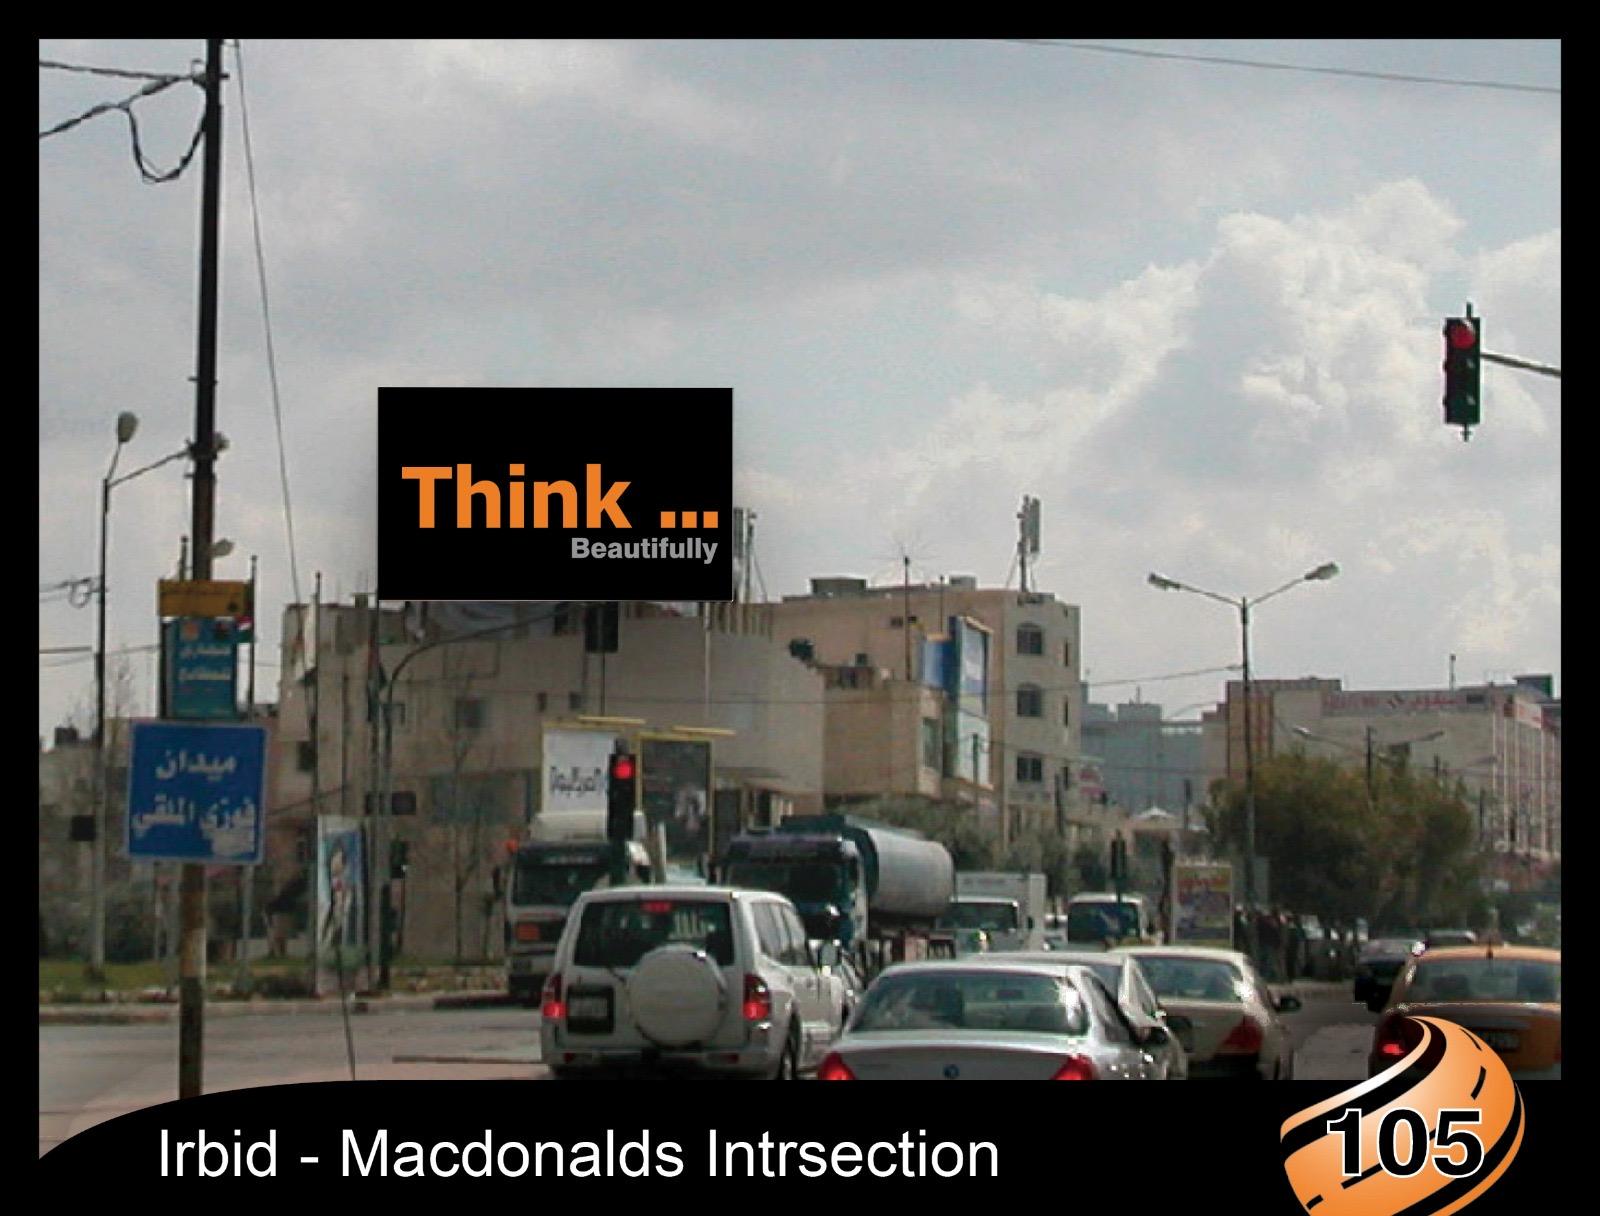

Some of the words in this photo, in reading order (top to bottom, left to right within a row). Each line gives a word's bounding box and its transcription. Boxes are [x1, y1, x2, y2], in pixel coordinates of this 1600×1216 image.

[402, 463, 633, 529] Think
[571, 537, 718, 565] Beautifully
[155, 750, 237, 782] ميدان
